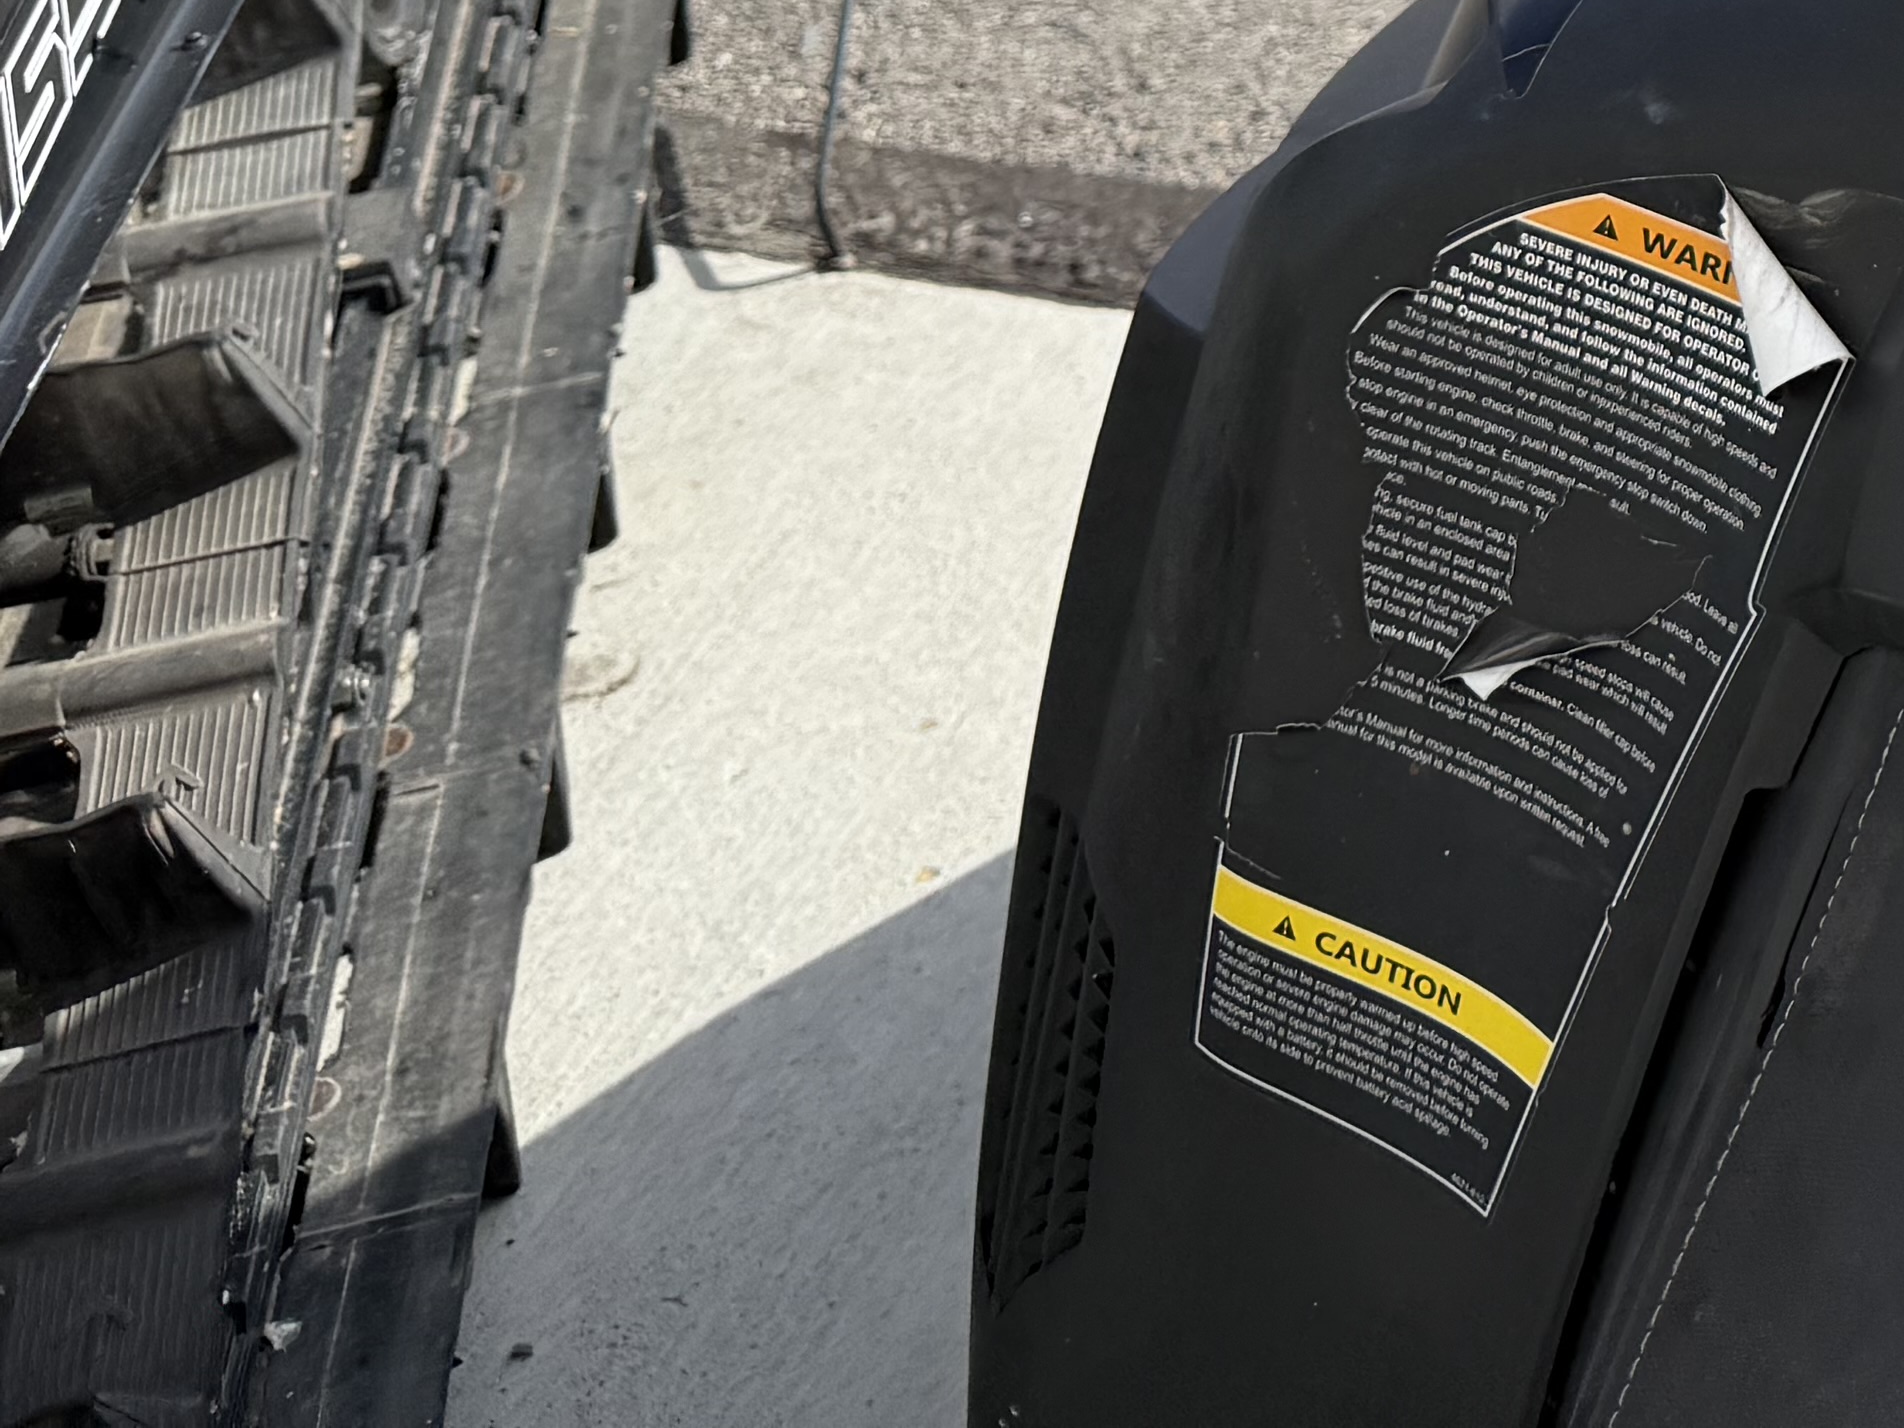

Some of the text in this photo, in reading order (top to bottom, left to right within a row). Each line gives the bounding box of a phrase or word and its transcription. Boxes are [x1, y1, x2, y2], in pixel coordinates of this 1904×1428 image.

[1470, 252, 1501, 273] THIS
[1506, 264, 1564, 295] VEHICLE
[1566, 287, 1580, 301] IS
[1584, 293, 1651, 329] DESIGNED
[1653, 321, 1680, 342] FOR
[1683, 334, 1749, 375] OPERATOR
[1491, 241, 1521, 259] ANY
[1524, 252, 1543, 266] OF
[1548, 260, 1573, 279] THE
[1575, 270, 1653, 310] FOLLOWING
[1656, 302, 1684, 323] ARE
[1686, 314, 1750, 352] IGNORED.
[1519, 232, 1573, 260] SEVERE
[1576, 252, 1627, 280] INJURY
[1629, 273, 1649, 289] OR
[1651, 281, 1687, 305] EVEN
[1689, 297, 1732, 325] DEATH
[1430, 280, 1777, 434] read, understand, and follow the information contained
[1431, 295, 1453, 312] the
[1456, 304, 1528, 338] Operator's
[1531, 330, 1580, 358] Manual
[1582, 352, 1608, 369] and
[1610, 363, 1627, 377] all
[1631, 369, 1680, 404] Warning
[1449, 265, 1494, 290] Before
[1497, 284, 1562, 317] operating
[1565, 306, 1590, 325] this
[1593, 320, 1673, 362] snowmobile,
[1676, 355, 1693, 369] all
[1695, 364, 1752, 400] operators
[1754, 394, 1783, 417] must
[1315, 931, 1461, 1015] CAUTION
